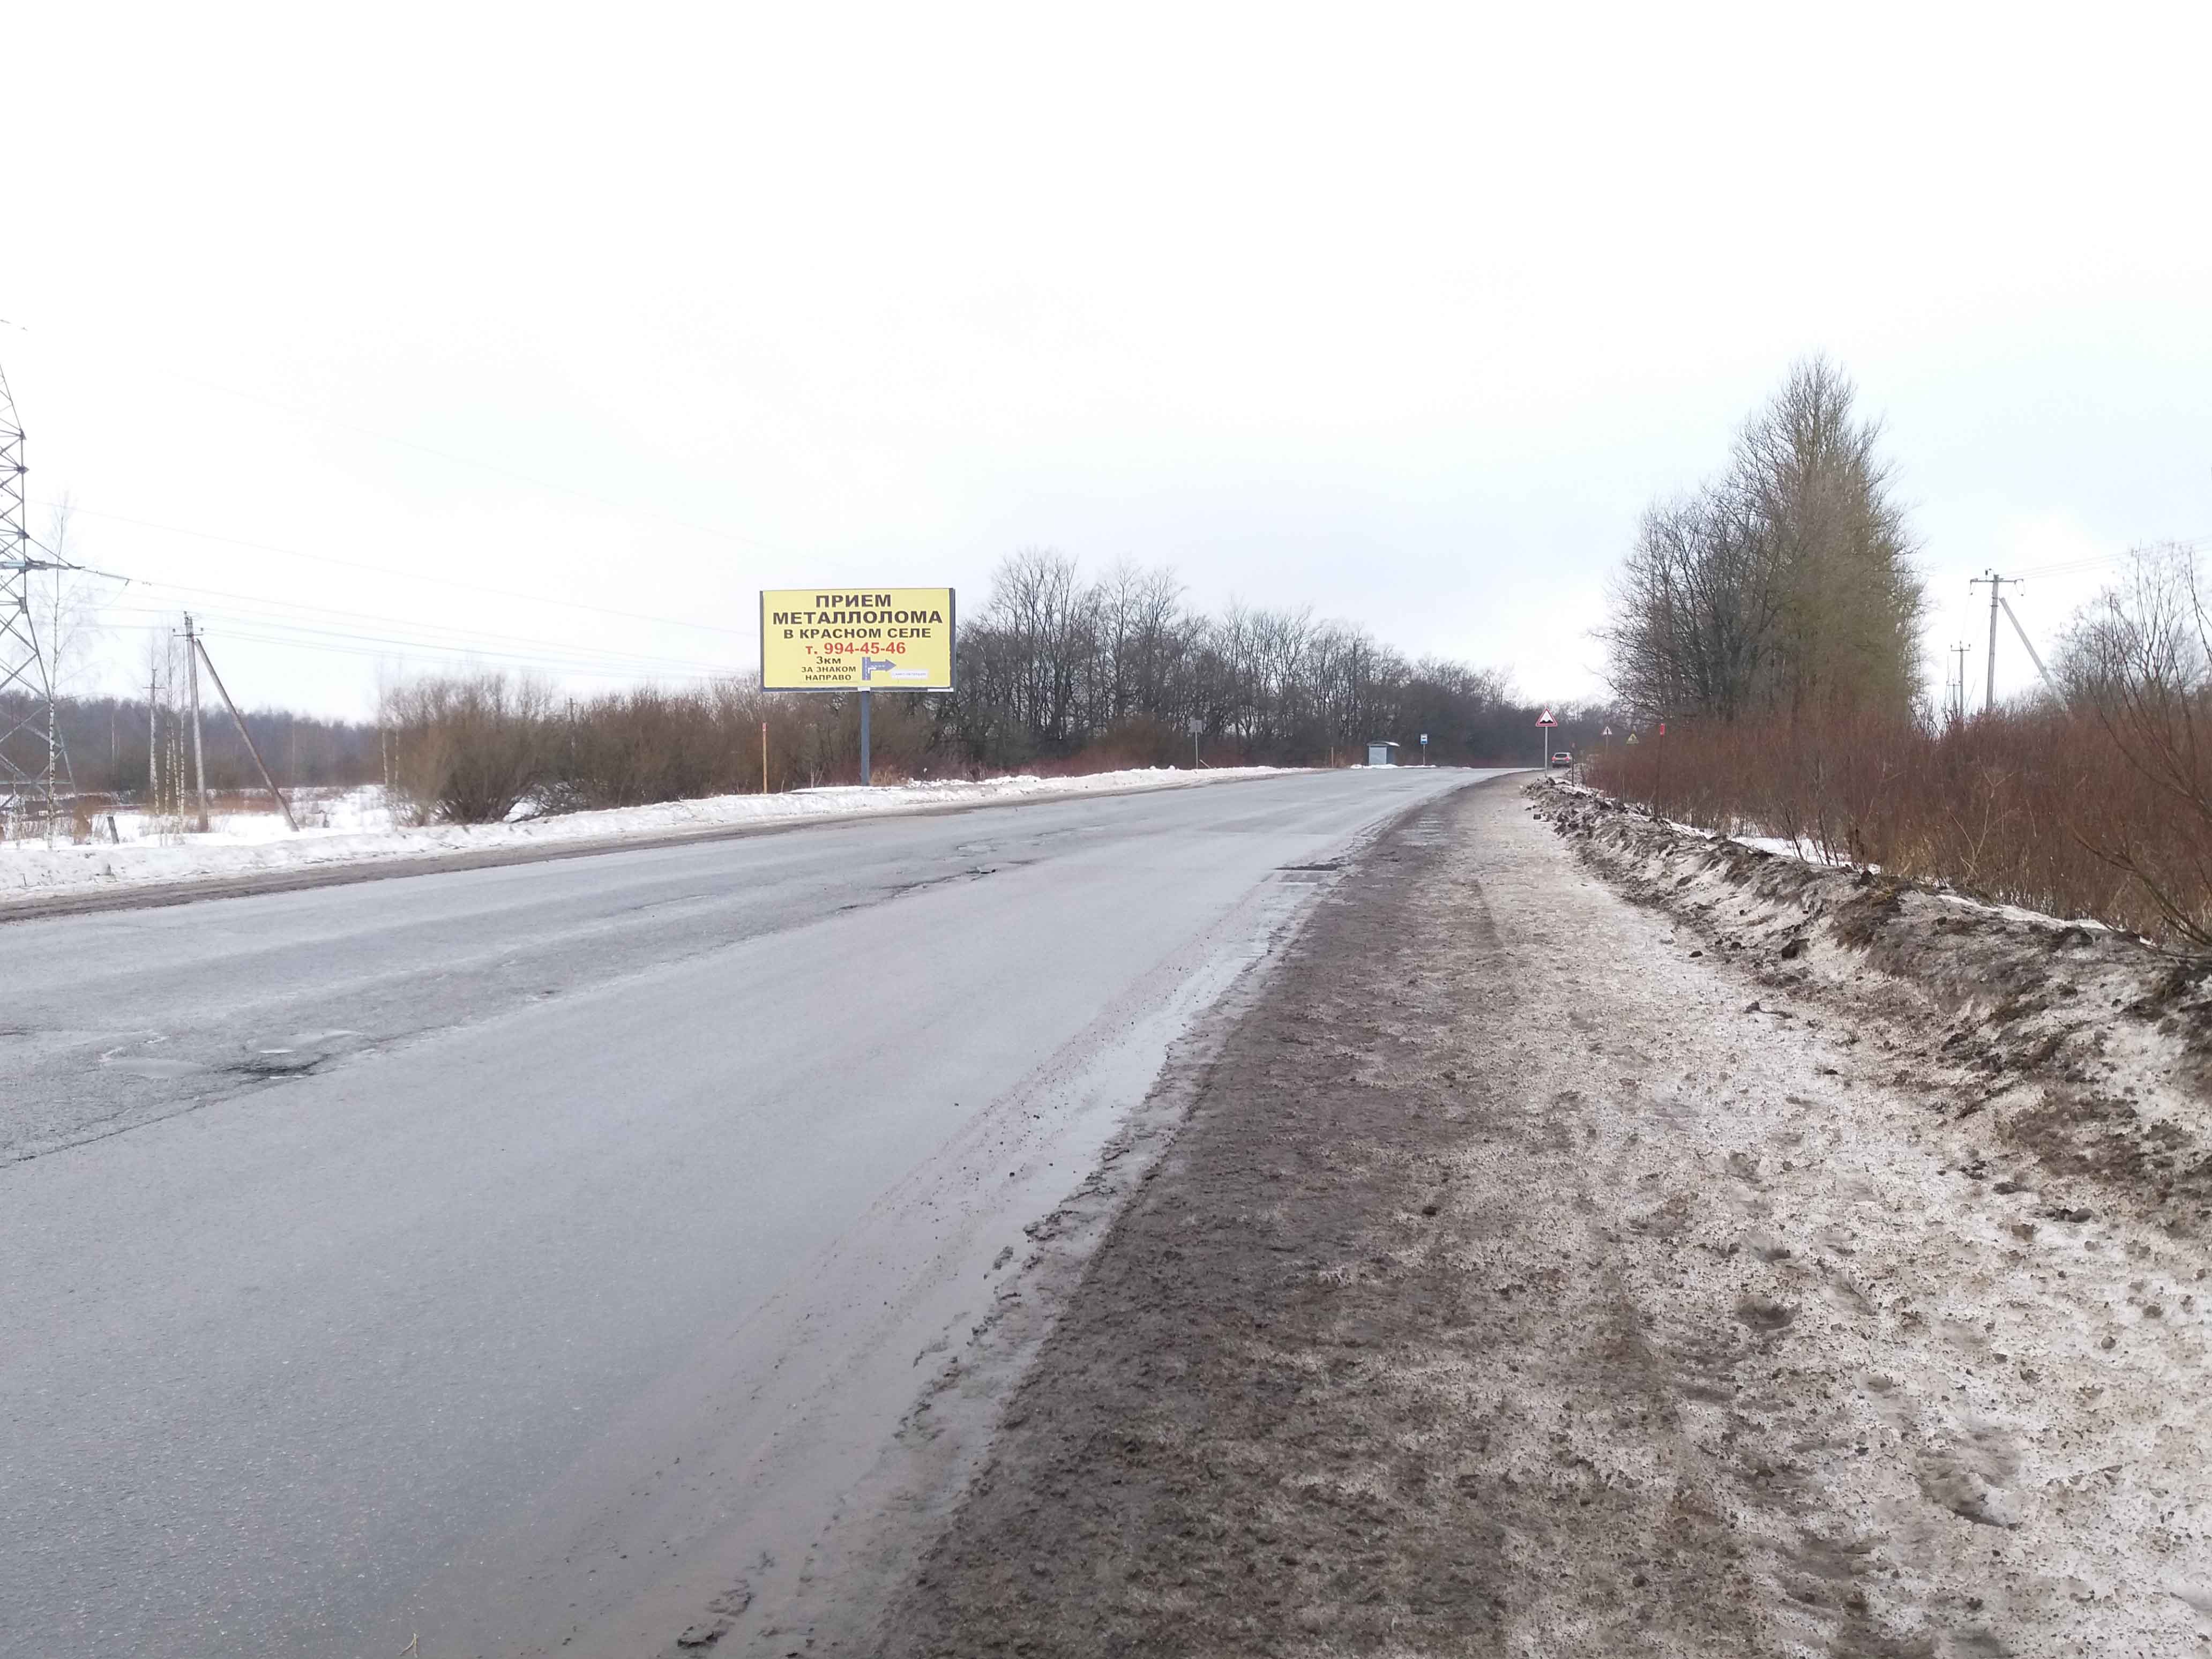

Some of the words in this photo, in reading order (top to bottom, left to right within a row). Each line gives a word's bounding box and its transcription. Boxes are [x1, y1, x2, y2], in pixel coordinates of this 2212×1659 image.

[816, 594, 891, 608] ПРИЕМ
[773, 611, 943, 625] МЕТАЛЛОЛОМА
[783, 629, 794, 639] В
[799, 629, 881, 639] КРАСНОМ
[887, 628, 931, 638] СЕЛЕ
[805, 645, 818, 654] т.
[824, 642, 906, 654] 994-45-46
